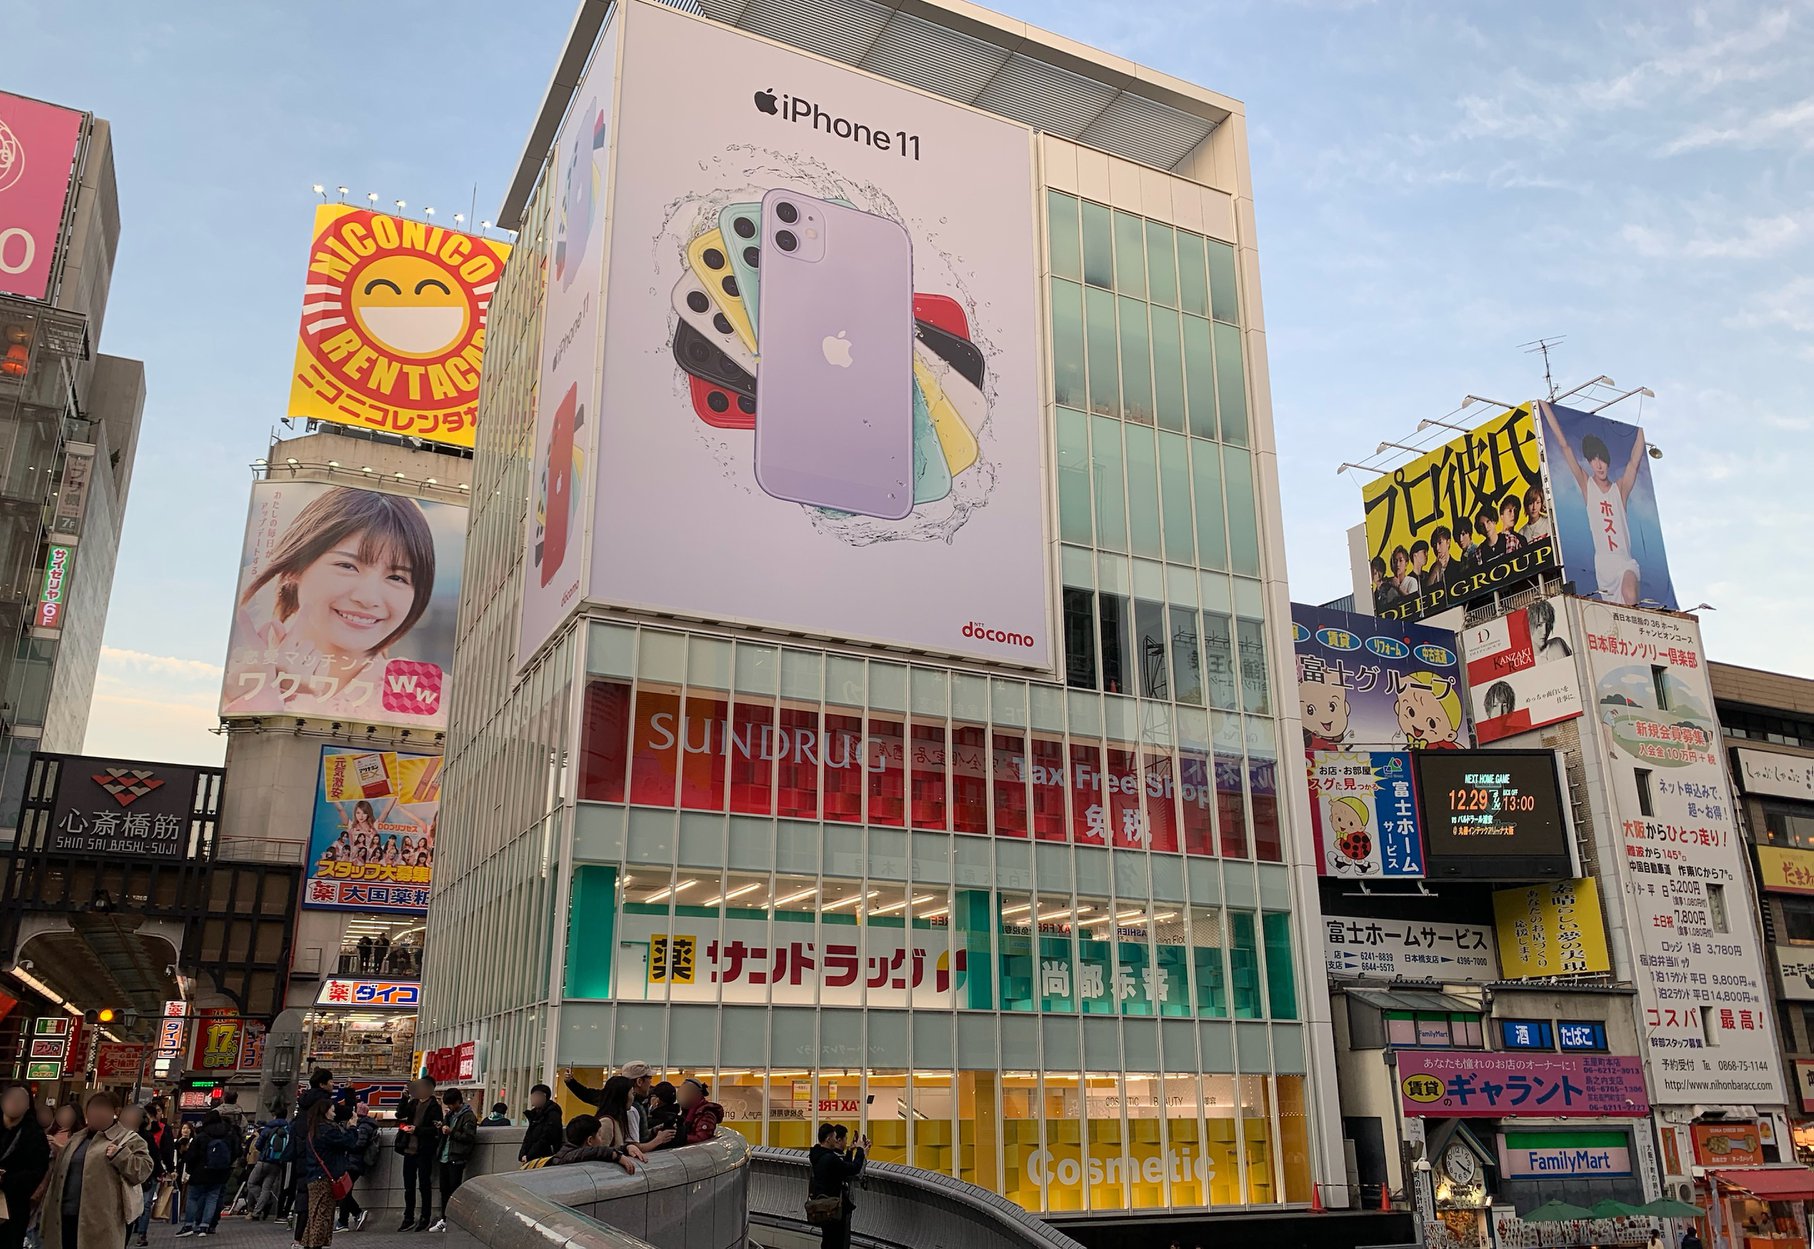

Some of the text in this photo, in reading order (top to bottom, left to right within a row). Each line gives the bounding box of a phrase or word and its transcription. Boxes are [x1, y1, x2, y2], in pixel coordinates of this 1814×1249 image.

[783, 94, 919, 160] iPhone 11
[309, 215, 495, 283] NICONICO
[1364, 409, 1540, 560] プロ彼氏
[61, 517, 75, 529] 7F
[1599, 500, 1619, 552] ホスト
[250, 502, 267, 575] アップデートする
[46, 549, 67, 599] サイゼリヤ
[1380, 546, 1552, 621] DEEP GROUP
[42, 603, 57, 626] 6F
[962, 621, 1034, 647] docomo
[1326, 631, 1351, 649] 賃貸
[1639, 627, 1694, 644] チャンピオンコース
[1374, 639, 1402, 656] リフォーム
[1587, 634, 1698, 669] 日本原カンツリー倶楽部
[1493, 648, 1531, 670] KANZAKI
[1508, 655, 1532, 673] RUKA
[1300, 654, 1456, 700] 富士グループ
[238, 671, 374, 707] ワクワク
[649, 712, 887, 773] SUNDRUG
[1638, 743, 1665, 758] 入会金
[330, 757, 346, 799] 元気激安
[360, 771, 381, 781] EX
[1319, 766, 1372, 776] お店・お部屋
[1465, 773, 1510, 784] NEXT HOME GAME
[1745, 761, 1800, 783] しゃぶしゃぶ
[1012, 757, 1064, 788] Tax
[1076, 764, 1138, 794] Free
[1147, 772, 1212, 809] Shop
[1309, 778, 1379, 791] スグに見つかる
[1659, 778, 1723, 801] ネット申込みで、
[1449, 789, 1488, 810] 12.29
[1503, 795, 1535, 811] 13:00
[58, 807, 182, 840] 心斎橋筋
[1085, 803, 1153, 843] 免税
[1392, 781, 1420, 872] 富士ホーム
[56, 836, 83, 850] SHIN
[87, 838, 107, 851] SAI
[1383, 820, 1399, 869] サービス
[1629, 859, 1672, 876] 中国自動車道
[312, 882, 336, 902] 薬
[1670, 879, 1701, 896] 5,200円
[1653, 909, 1707, 929] 土日祝 7,800円
[1326, 919, 1488, 950] 富士ホームサービス
[654, 939, 692, 980] 薬
[1360, 951, 1394, 962] 6241-8839
[1661, 941, 1742, 957] ロッジ 1泊 3,780円
[707, 939, 927, 989] サンドラッグ
[1361, 962, 1395, 973] 6644-5573
[1404, 954, 1488, 967] 日本橋支店 4396-7000
[1690, 972, 1707, 985] 平日
[328, 981, 350, 1002] 薬
[1693, 988, 1709, 1001] 平日
[1647, 1007, 1698, 1028] コスパ
[1418, 1029, 1449, 1039] FamilyMart
[1515, 1025, 1530, 1045] 酒
[1561, 1026, 1593, 1046] たばこ
[204, 1055, 235, 1068] OFF
[1661, 1058, 1695, 1072] 予約受付
[1718, 1060, 1768, 1072] 0868-75-1144
[1408, 1080, 1439, 1097] 賃貸
[1447, 1072, 1584, 1106] ギャラント
[1664, 1078, 1774, 1092] http://www.nihonbaracc.com
[1443, 1098, 1453, 1107] の
[1027, 1148, 1216, 1186] Cosmetic
[1529, 1150, 1611, 1173] FamilyMart
